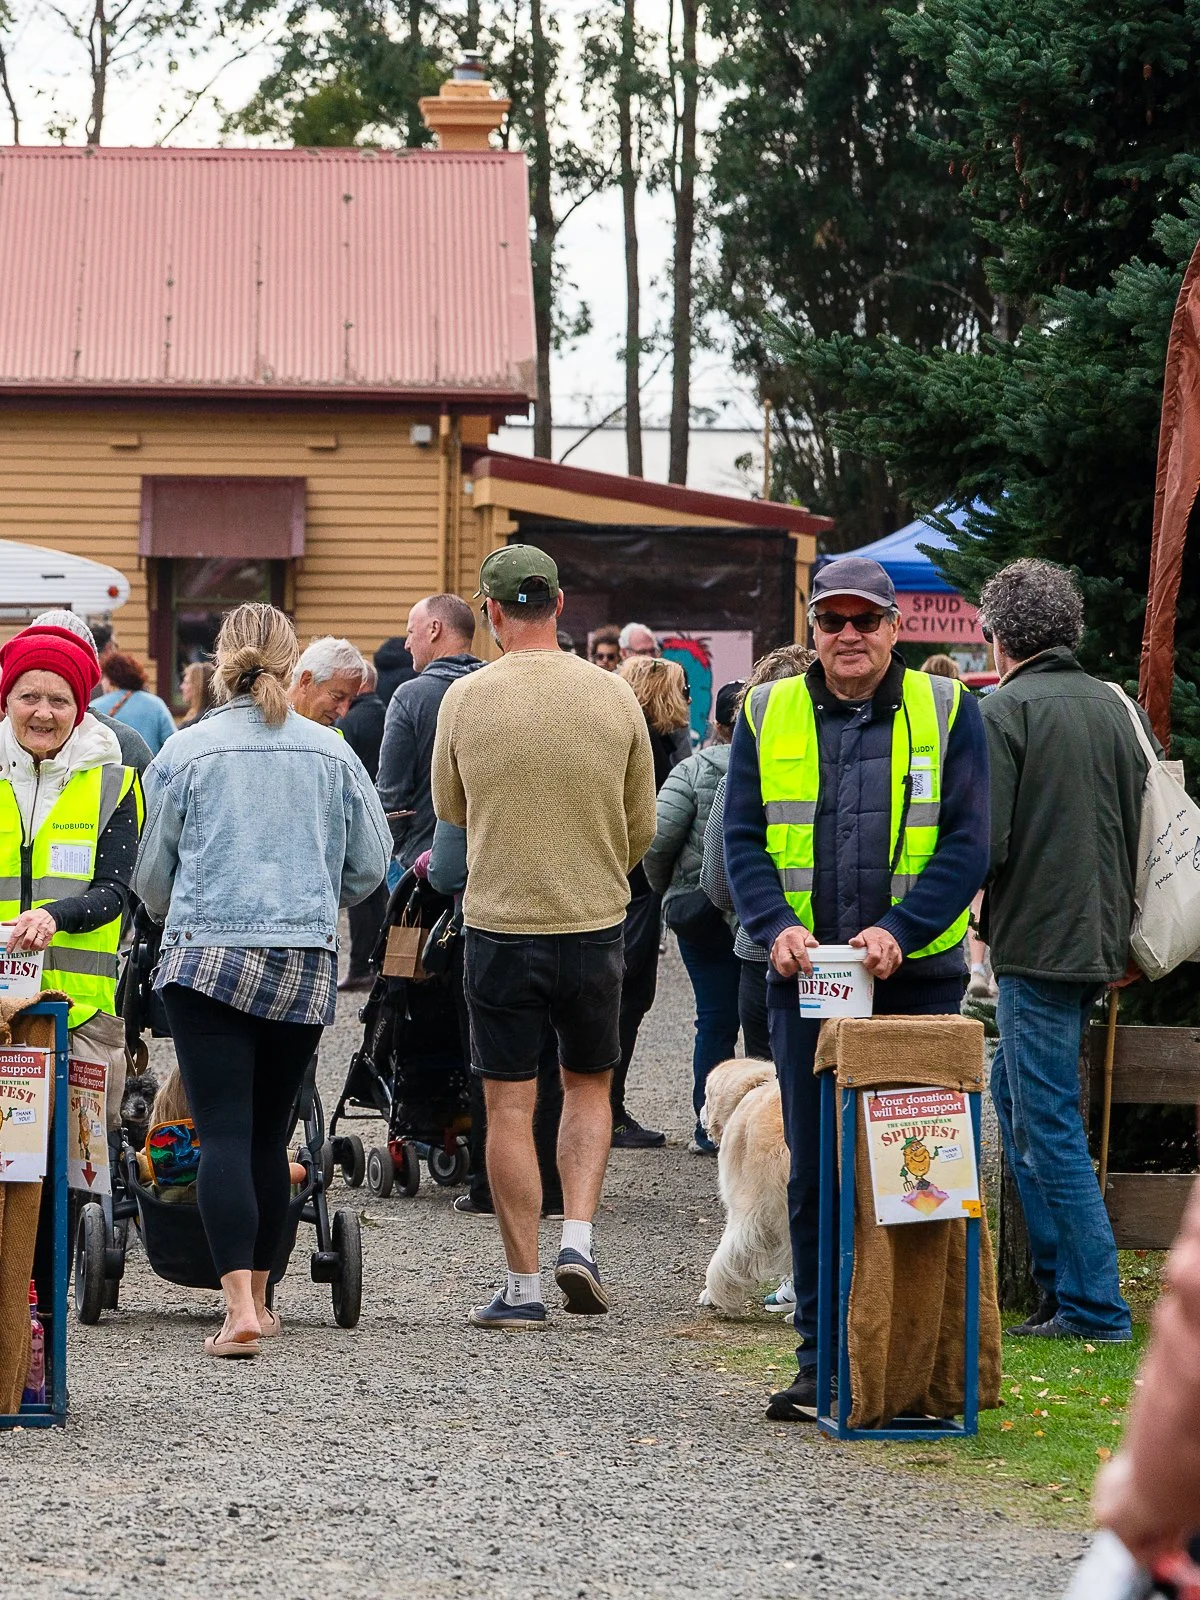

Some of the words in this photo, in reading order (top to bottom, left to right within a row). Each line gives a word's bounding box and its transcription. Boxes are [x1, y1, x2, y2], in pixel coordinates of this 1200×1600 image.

[912, 595, 961, 614] SPUD
[52, 822, 94, 830] SPUDBUDDY
[815, 971, 852, 979] TRENTHAM
[1, 1065, 42, 1076] support
[73, 1062, 83, 1073] Your
[83, 1065, 102, 1077] donation
[78, 1074, 88, 1086] help
[88, 1078, 104, 1089] support
[878, 1097, 904, 1107] Your
[906, 1092, 954, 1104] donation
[872, 1107, 892, 1118] will
[895, 1105, 919, 1116] help
[921, 1102, 962, 1114] support
[900, 1120, 919, 1128] GREAT
[920, 1118, 952, 1126] TRENTHAM
[880, 1125, 960, 1147] SPUDFEST
